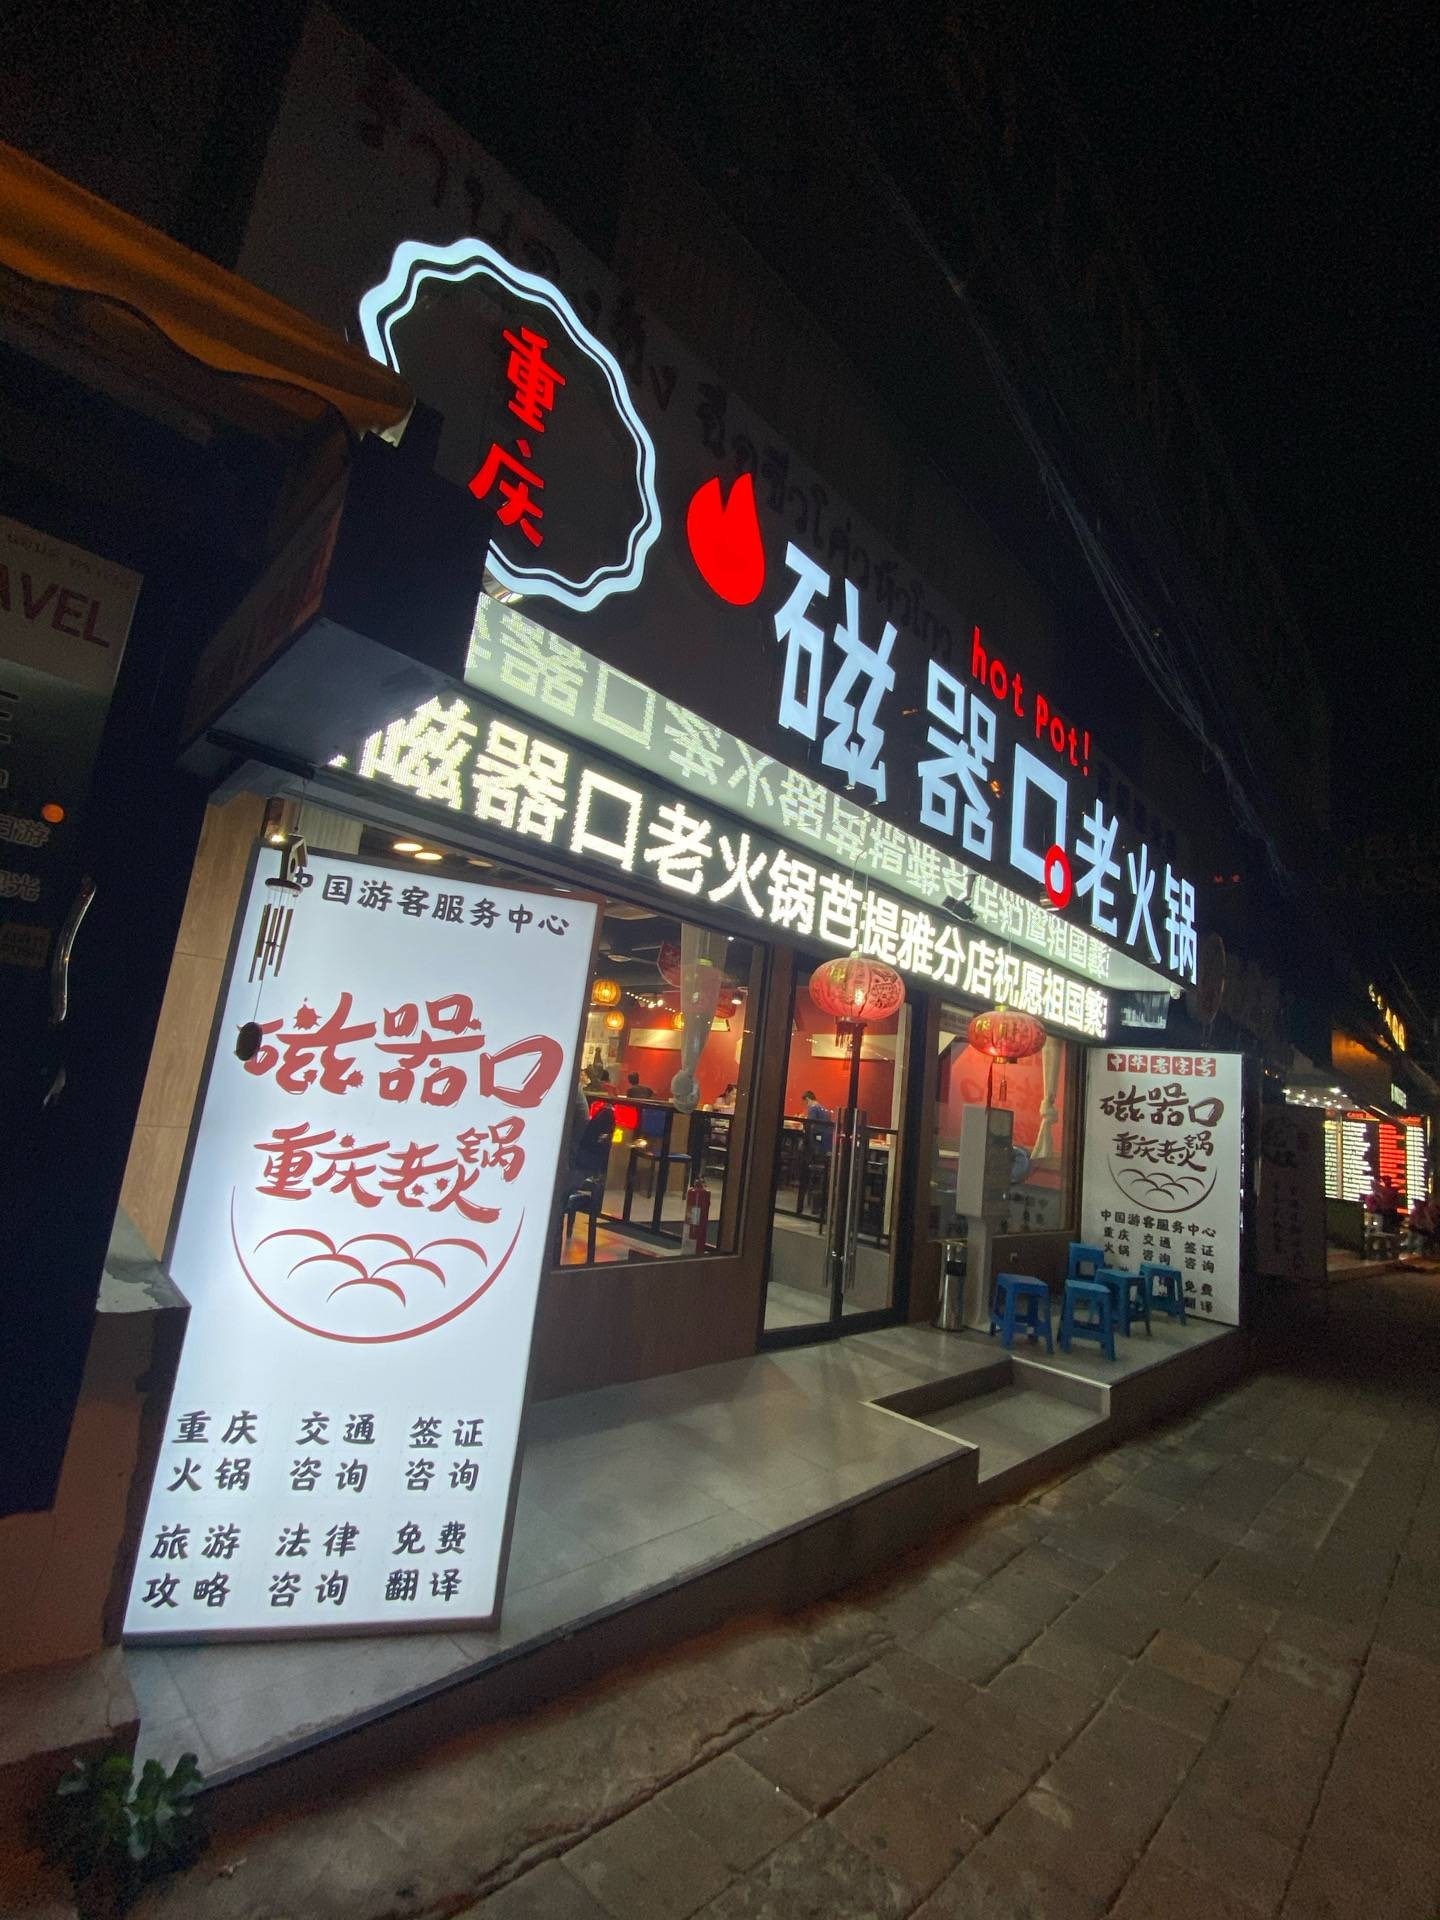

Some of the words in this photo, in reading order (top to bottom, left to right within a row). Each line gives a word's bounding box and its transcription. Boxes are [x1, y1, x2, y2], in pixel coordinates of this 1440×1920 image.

[468, 327, 566, 547] 重庆
[972, 625, 1023, 717] hot
[236, 992, 564, 1109] 磁器口
[1099, 1082, 1225, 1128] 磁器口
[1100, 1209, 1217, 1238] 中国游客服务中心
[1103, 1226, 1130, 1242] 重庆
[1142, 1233, 1172, 1250] 交通
[1184, 1241, 1215, 1257] 签证
[1104, 1241, 1130, 1257] 火锅
[1142, 1249, 1171, 1266] 咨询
[1184, 1256, 1215, 1274] 咨询
[172, 1409, 258, 1445] 重庆
[296, 1410, 376, 1445] 交通
[409, 1416, 485, 1449] 签证
[166, 1456, 252, 1492] 火锅
[290, 1456, 368, 1492] 咨询
[404, 1458, 480, 1492] 咨询
[150, 1522, 242, 1560] 旅游
[275, 1521, 360, 1558] 法律
[392, 1520, 467, 1556] 免费
[142, 1572, 232, 1608] 攻略
[268, 1571, 349, 1607] 咨询
[385, 1568, 464, 1602] 翻译
